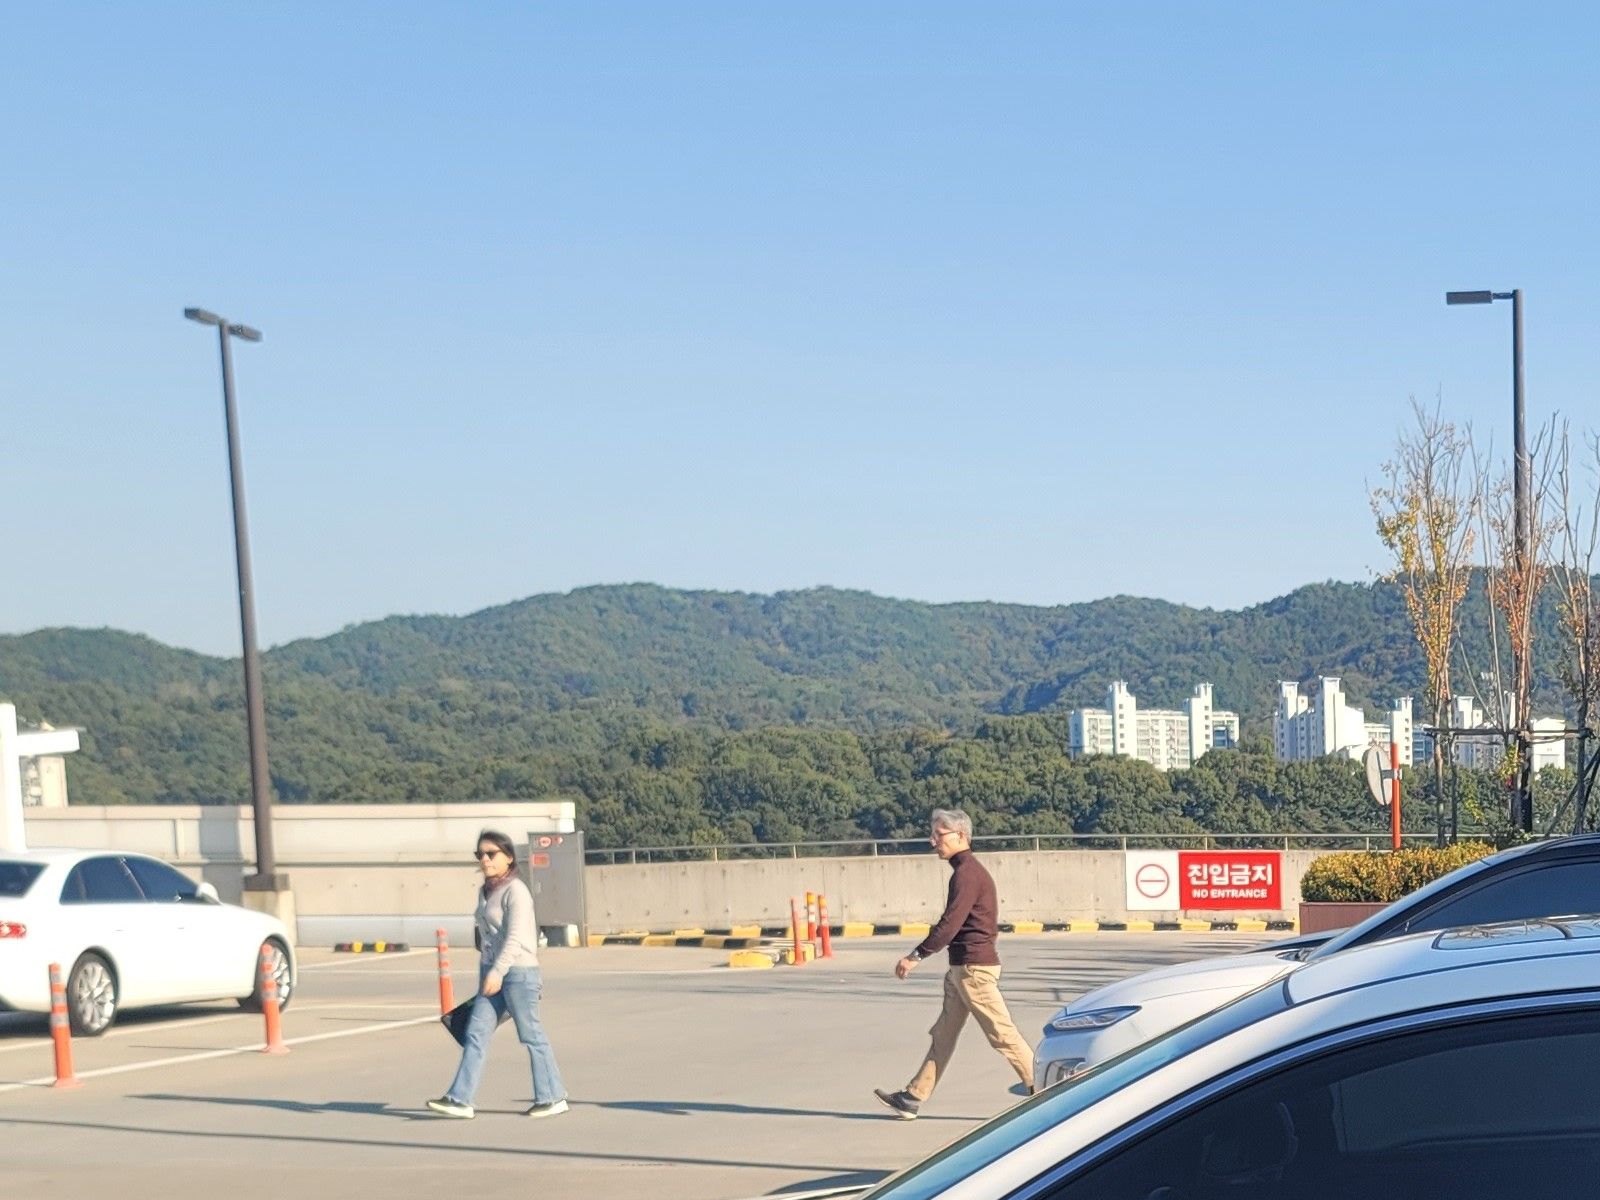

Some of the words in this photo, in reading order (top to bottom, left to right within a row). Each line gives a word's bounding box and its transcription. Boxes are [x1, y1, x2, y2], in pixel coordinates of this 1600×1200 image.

[1187, 863, 1273, 886] 진입금지
[1192, 889, 1209, 899] NO
[1210, 889, 1268, 899] ENTRANCE
